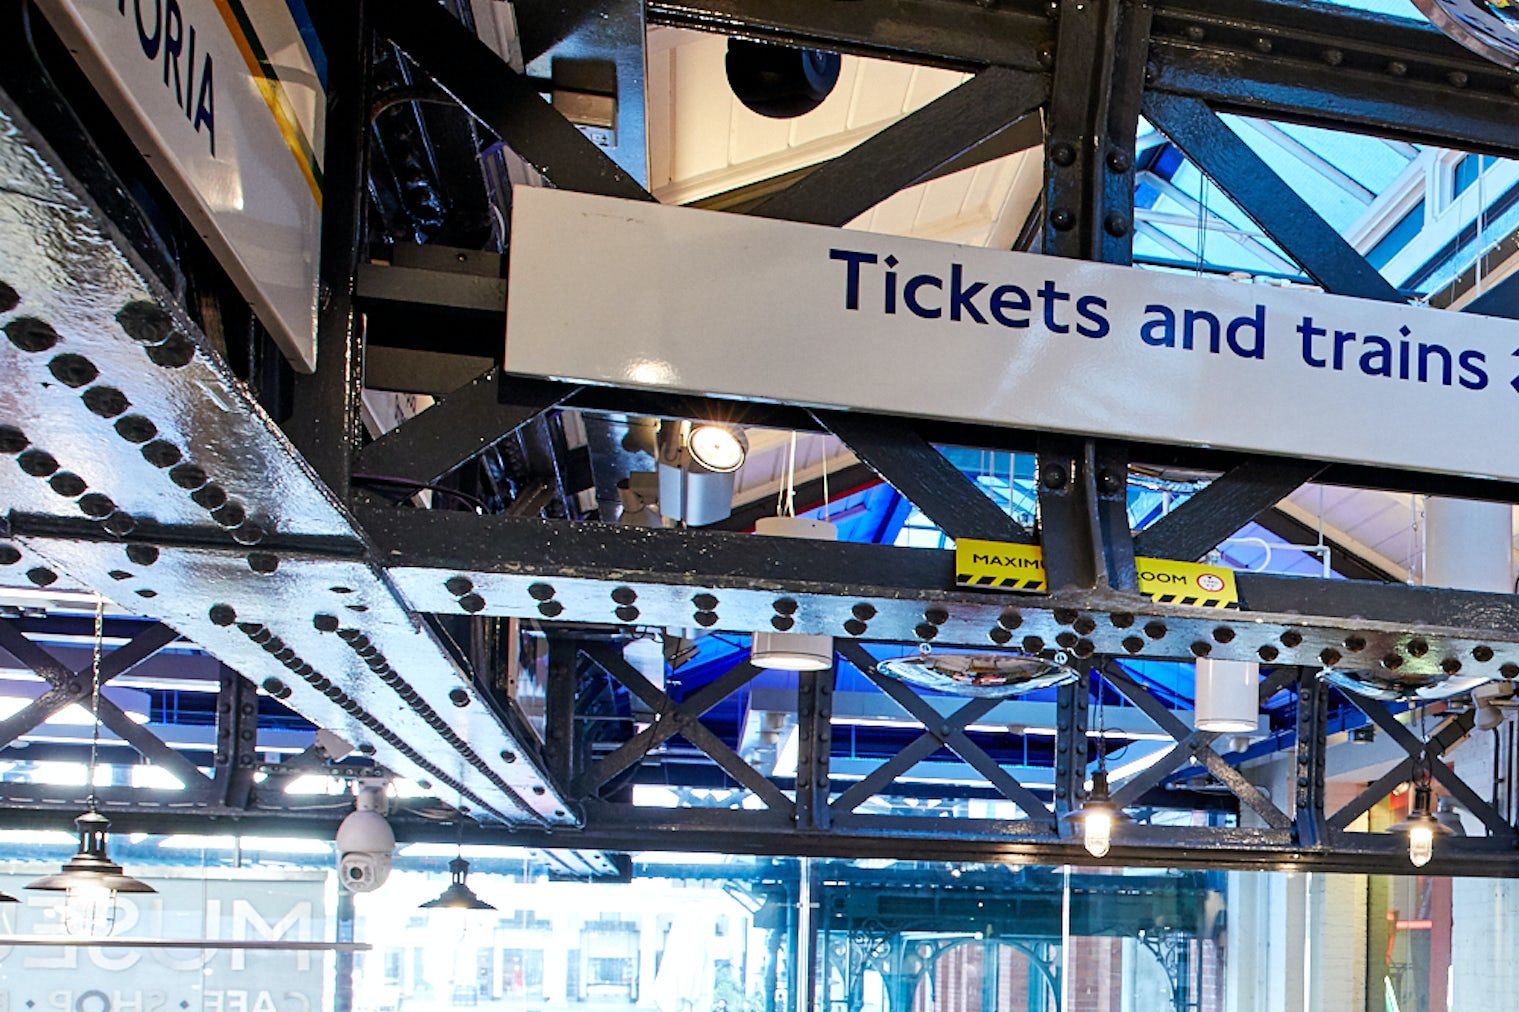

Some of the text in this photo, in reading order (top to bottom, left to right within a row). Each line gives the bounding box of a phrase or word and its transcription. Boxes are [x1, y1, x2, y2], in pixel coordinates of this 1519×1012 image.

[118, 0, 216, 158] ORIA
[828, 248, 1490, 390] Tickets and trains
[972, 553, 1045, 569] MAXIM
[1137, 571, 1187, 585] OOM
